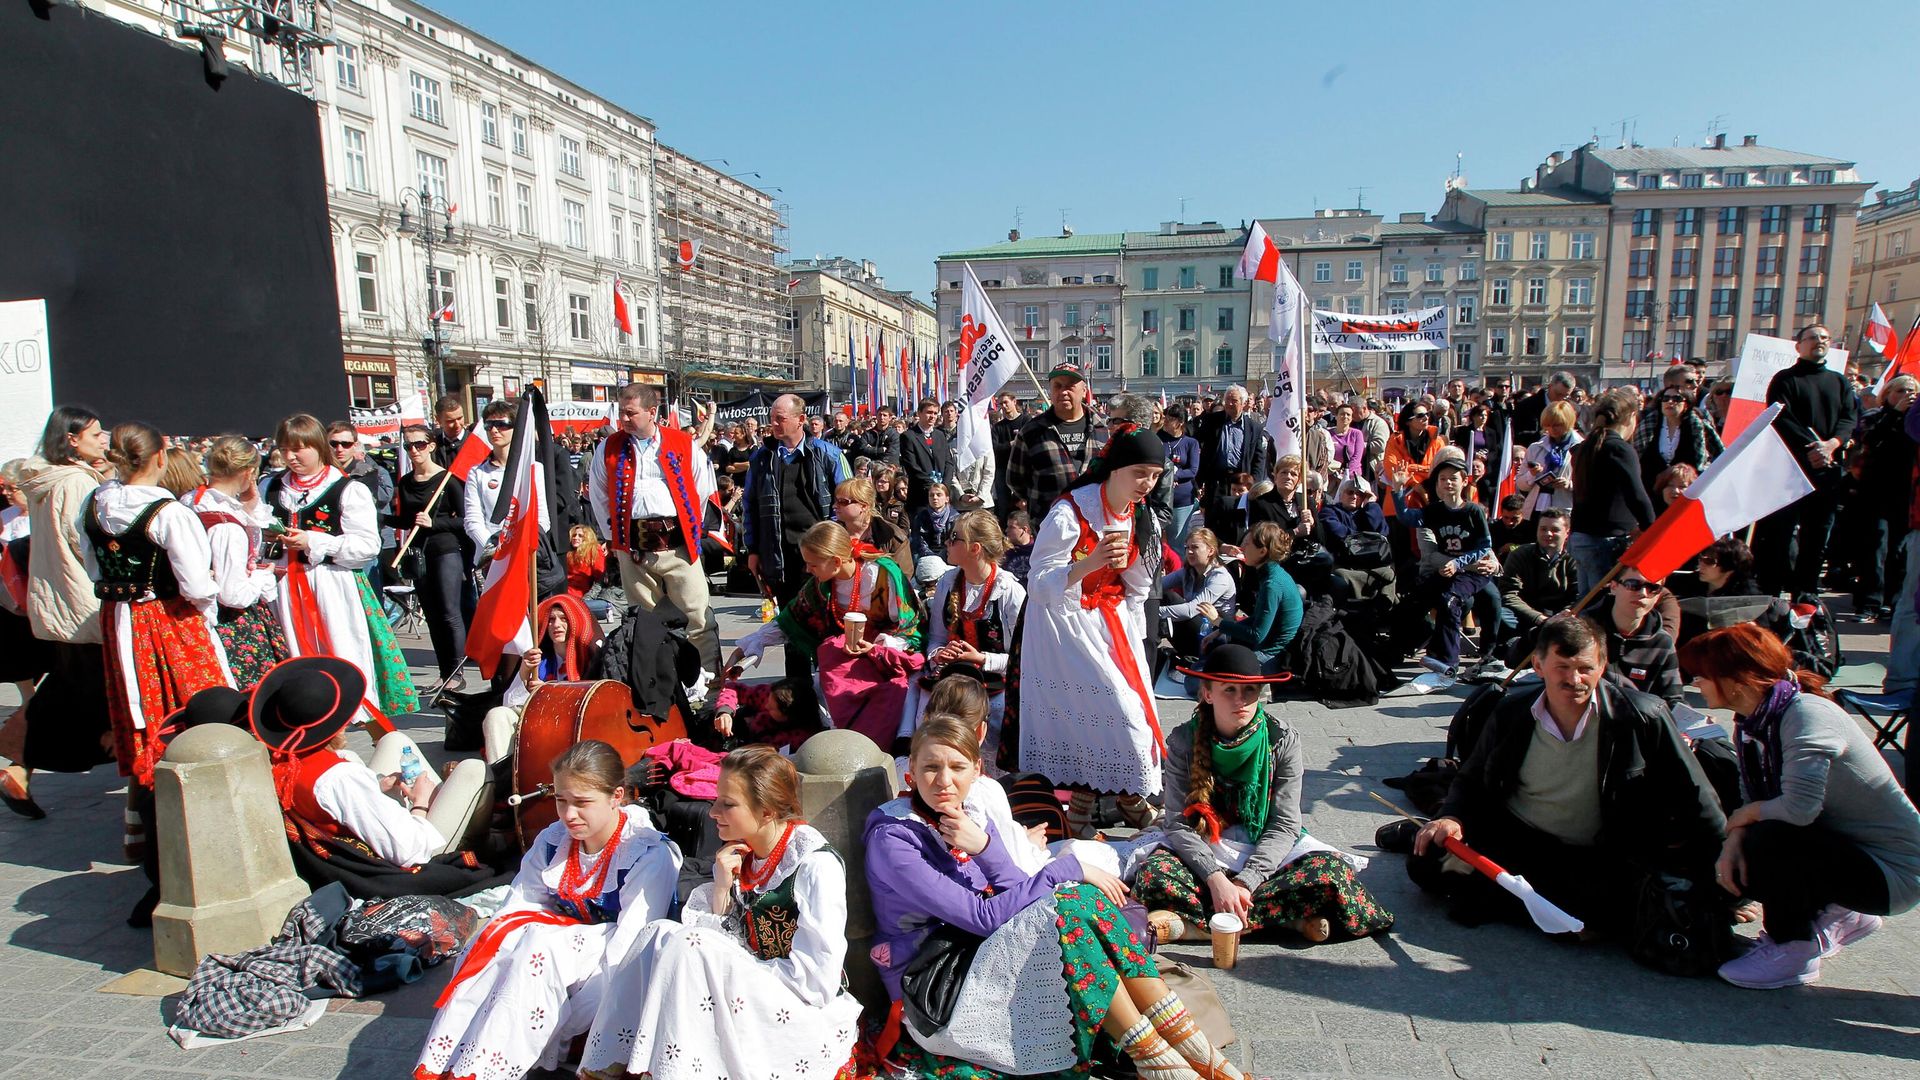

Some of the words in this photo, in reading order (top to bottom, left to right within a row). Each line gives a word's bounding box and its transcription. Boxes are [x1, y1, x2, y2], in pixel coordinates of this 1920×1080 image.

[1315, 315, 1339, 331] 1940
[1347, 315, 1414, 331] KATYŃ
[1421, 309, 1445, 329] 2010
[1314, 333, 1350, 345] ŁĄCZY
[1357, 333, 1380, 343] NAS
[1388, 331, 1445, 342] HISTORIA
[548, 406, 599, 417] czowa
[719, 405, 771, 419] Włoszczo
[1446, 538, 1462, 551] 13
